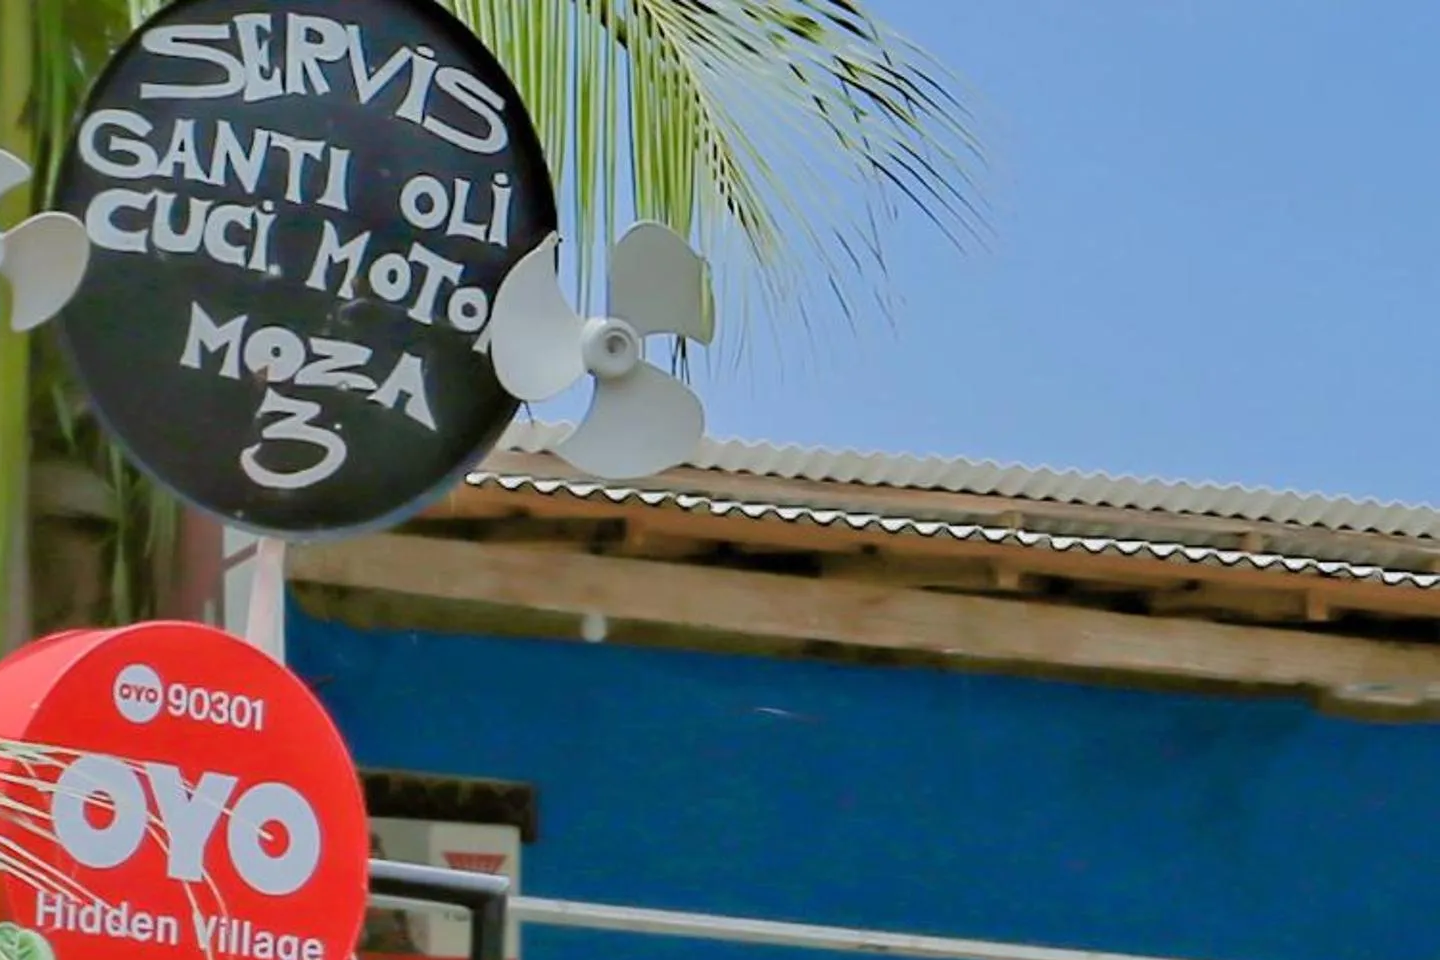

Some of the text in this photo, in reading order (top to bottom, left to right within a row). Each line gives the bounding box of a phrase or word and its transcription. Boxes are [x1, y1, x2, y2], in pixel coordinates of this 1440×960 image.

[77, 108, 351, 212] GANTI
[304, 219, 494, 355] MOTO
[178, 300, 438, 432] MOZA
[239, 388, 348, 489] 3
[118, 682, 265, 732] OYO 90301
[51, 753, 323, 897] OYO
[34, 889, 179, 946] Hidden
